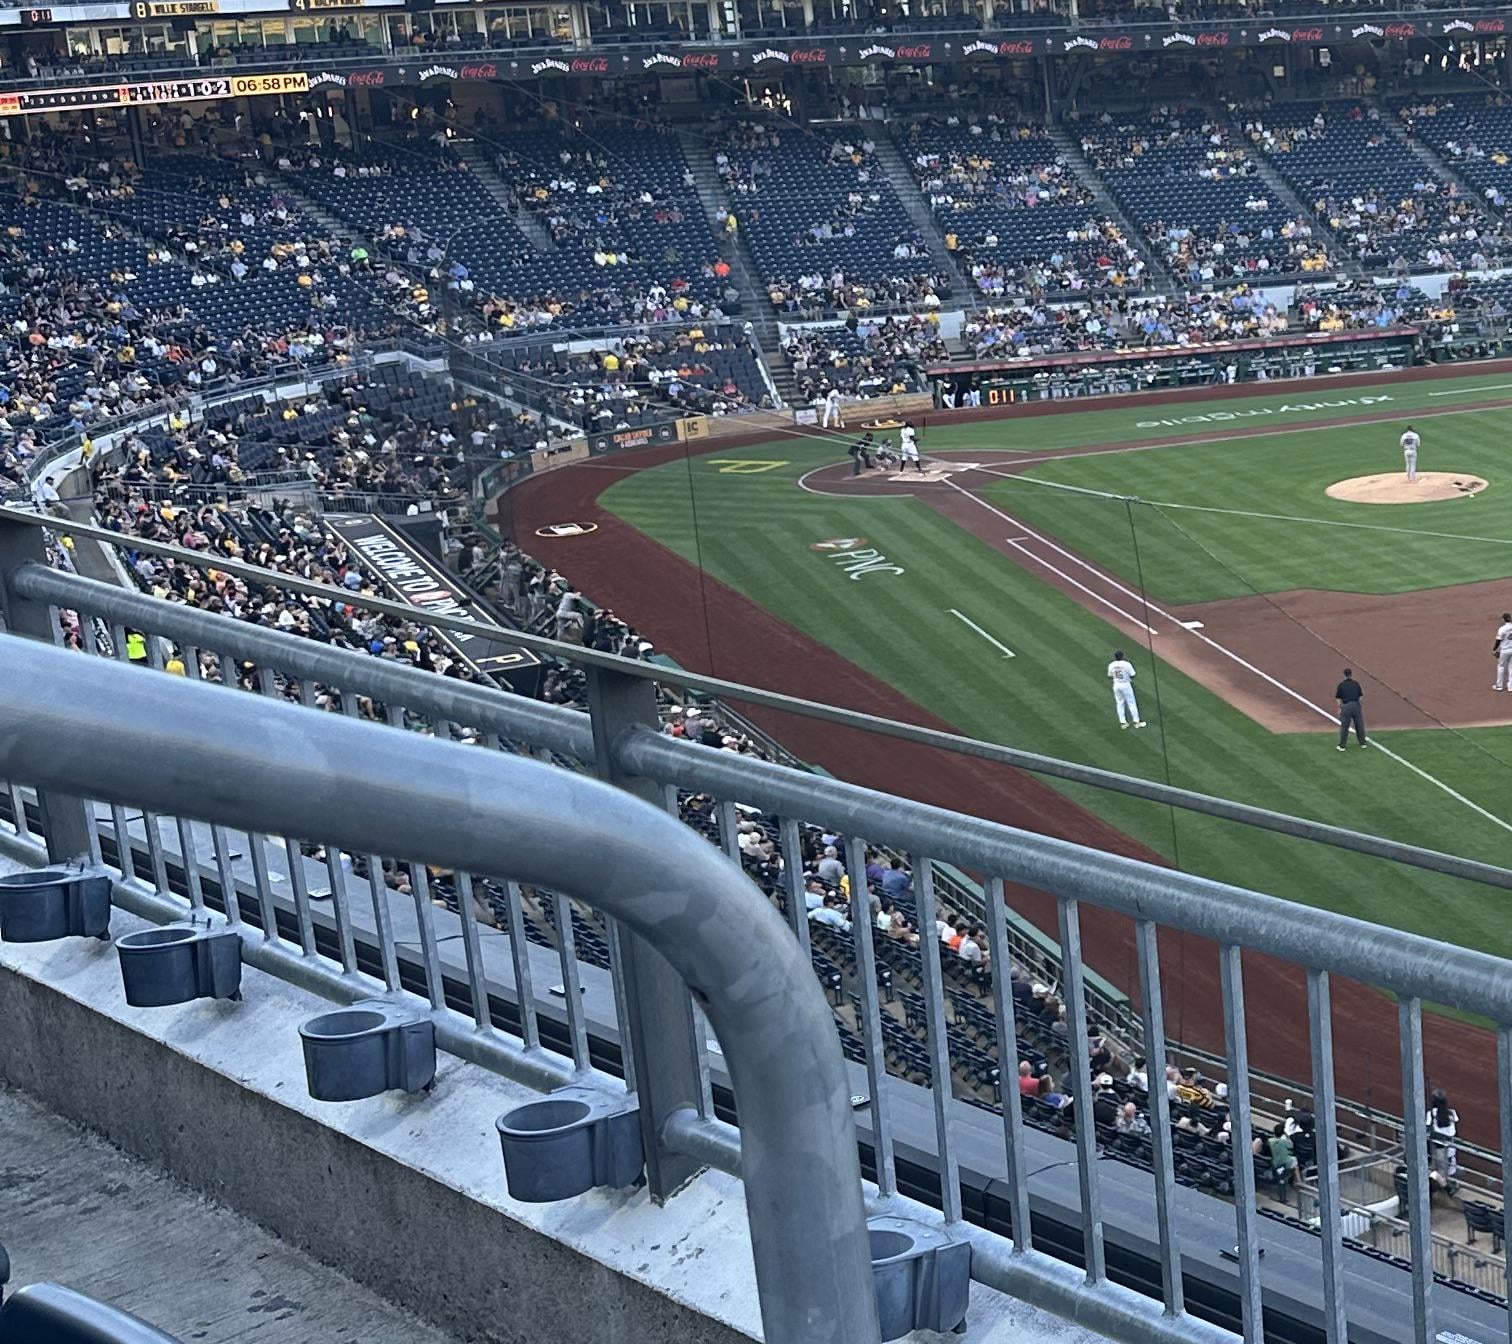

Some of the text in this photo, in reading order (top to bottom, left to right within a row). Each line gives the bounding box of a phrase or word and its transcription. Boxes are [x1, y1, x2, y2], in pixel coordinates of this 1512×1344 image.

[136, 2, 147, 18] 8
[201, 82, 212, 96] 0
[217, 82, 227, 95] 2
[237, 76, 306, 92] 06:58 PM
[1136, 394, 1395, 428] xfinity mobile
[354, 534, 427, 580] WELCOME
[397, 575, 440, 593] TO
[827, 548, 905, 581] PNC
